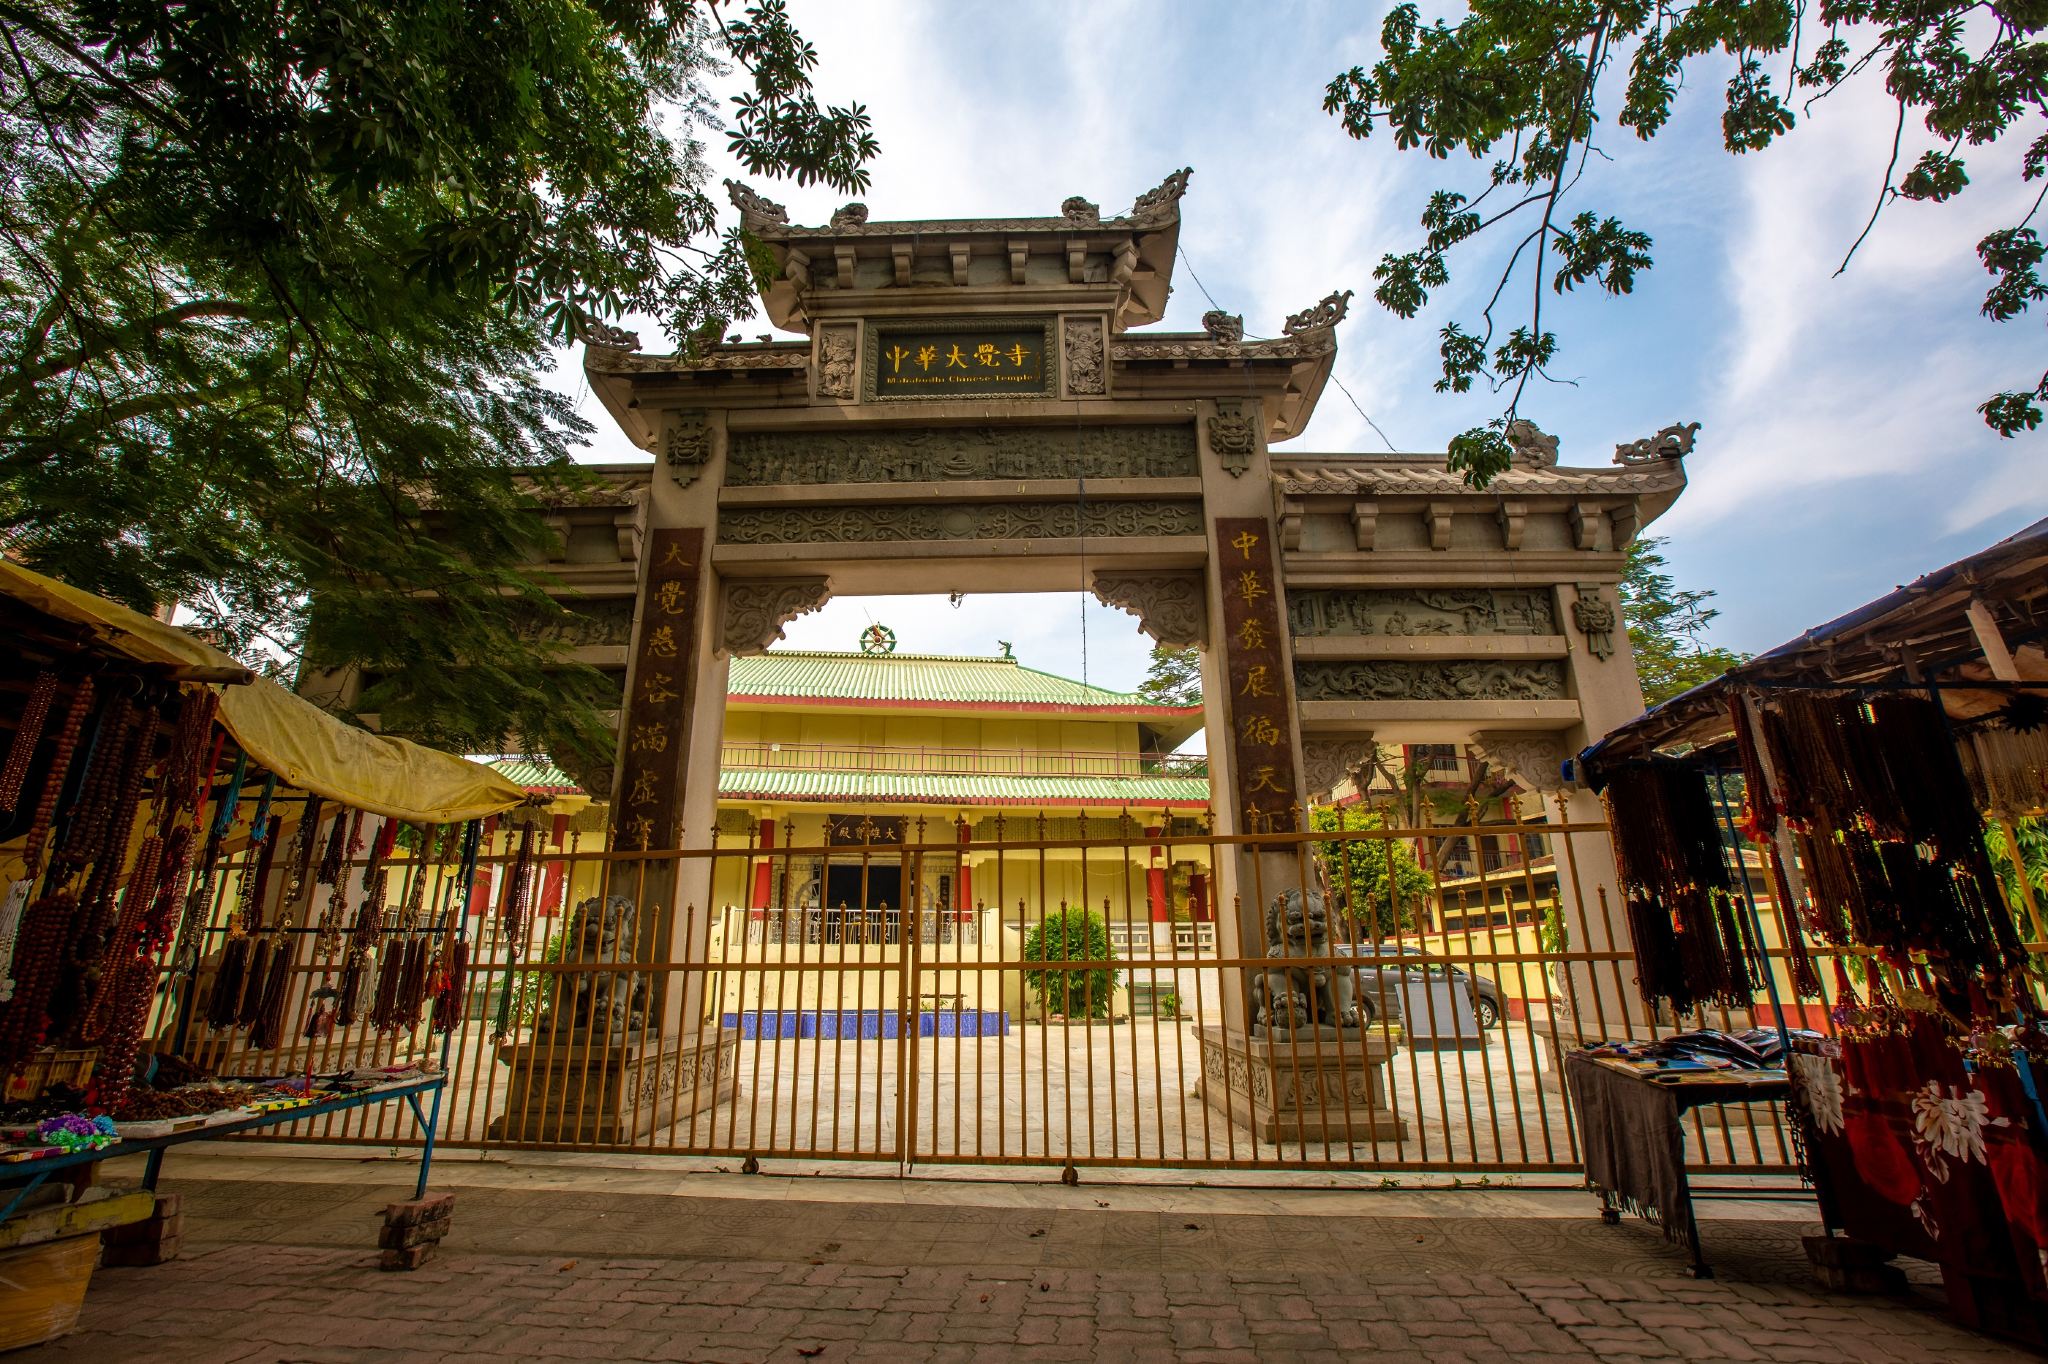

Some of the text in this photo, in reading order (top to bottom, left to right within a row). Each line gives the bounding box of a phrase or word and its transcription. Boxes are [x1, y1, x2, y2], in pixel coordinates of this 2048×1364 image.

[886, 343, 1031, 373] 中華大覺寺
